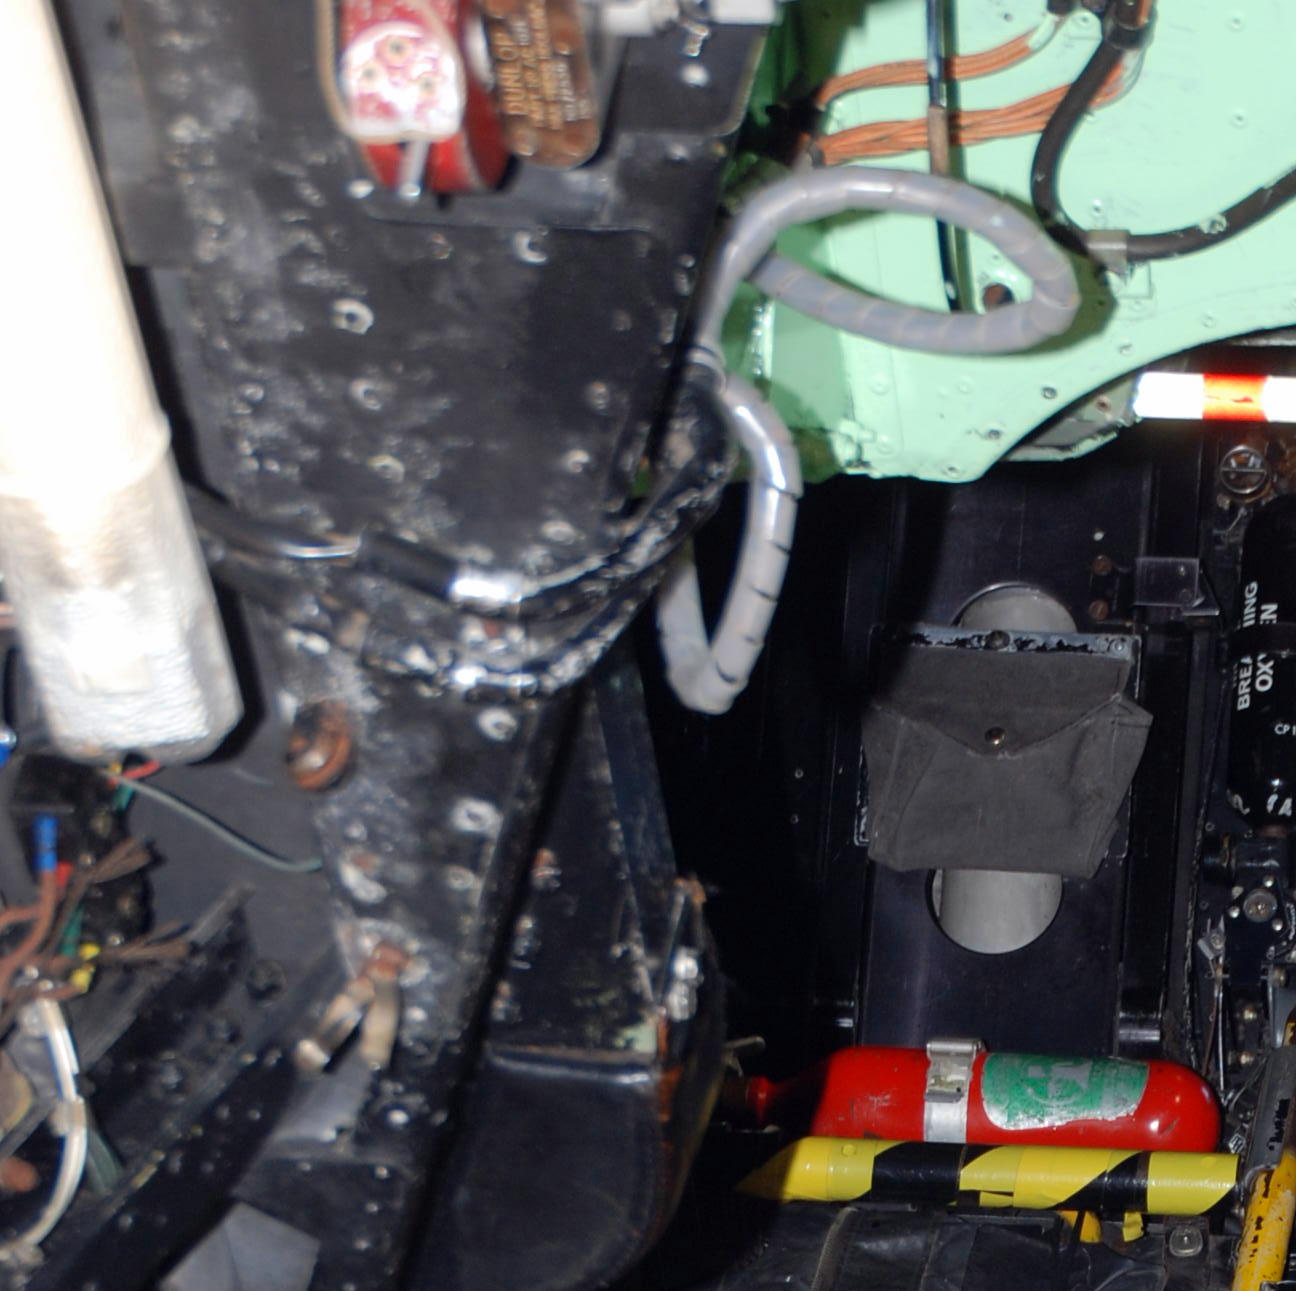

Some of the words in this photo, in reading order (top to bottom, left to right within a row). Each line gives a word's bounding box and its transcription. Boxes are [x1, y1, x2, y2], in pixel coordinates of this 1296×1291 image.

[491, 31, 526, 115] DUNLOP
[1237, 581, 1259, 711] BREAING
[1255, 603, 1278, 692] OXEN
[1274, 722, 1291, 735] CP
